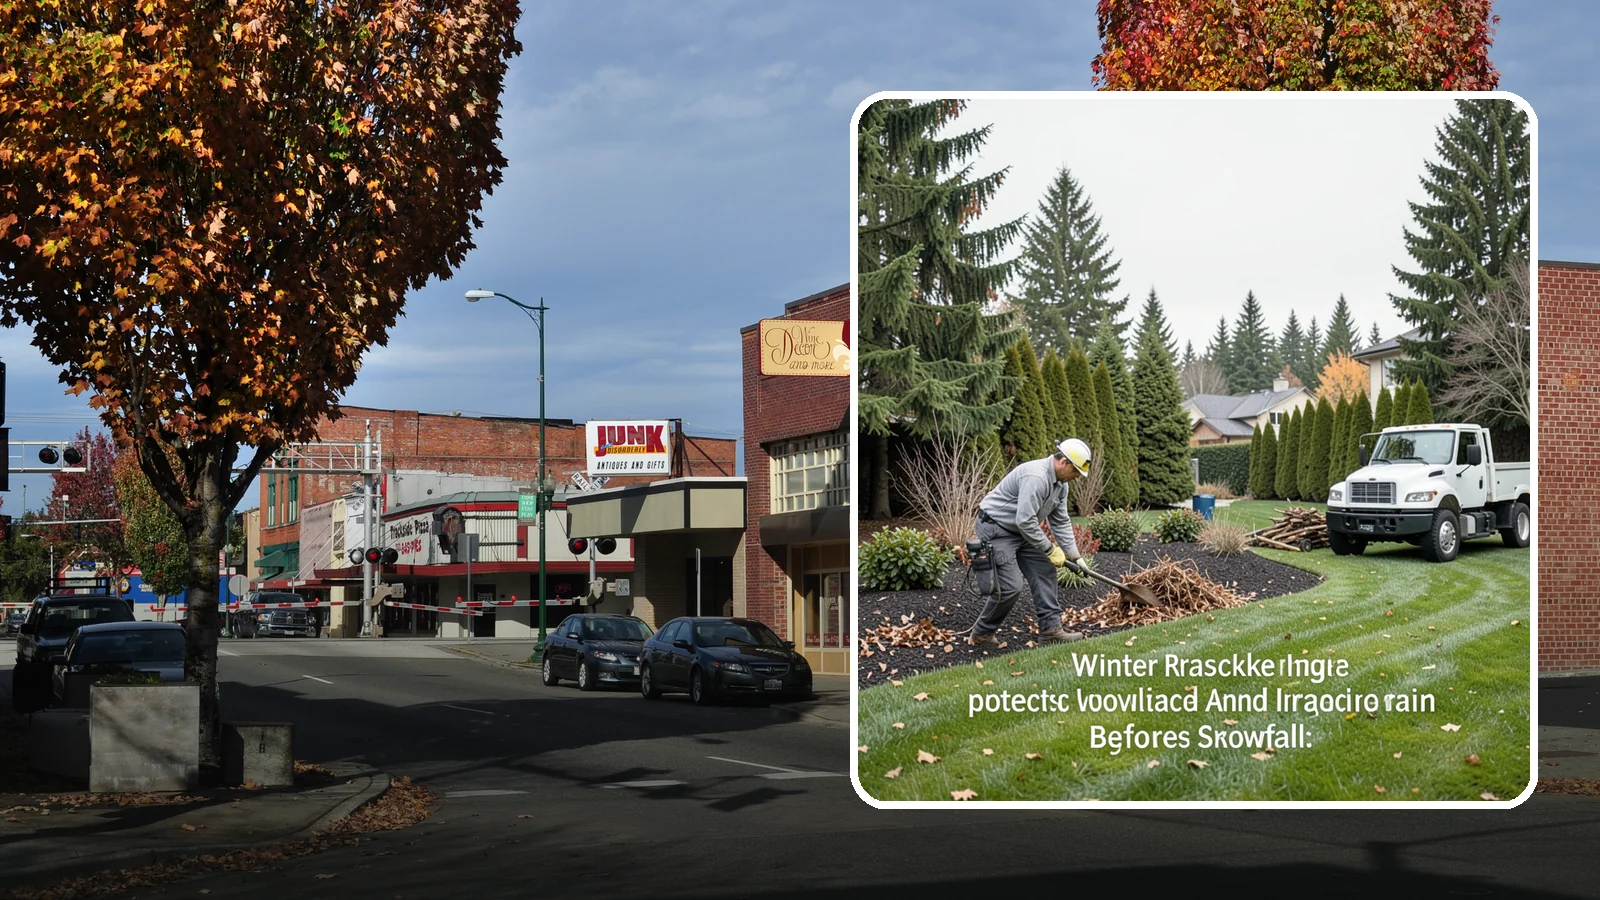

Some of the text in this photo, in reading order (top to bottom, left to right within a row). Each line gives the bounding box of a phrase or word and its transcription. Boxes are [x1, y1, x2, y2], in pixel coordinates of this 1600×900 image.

[595, 425, 666, 457] JUNK
[607, 446, 646, 454] DISORDERLY
[597, 460, 666, 470] ANTIQUES AND GIFTS
[415, 520, 428, 534] Pizza
